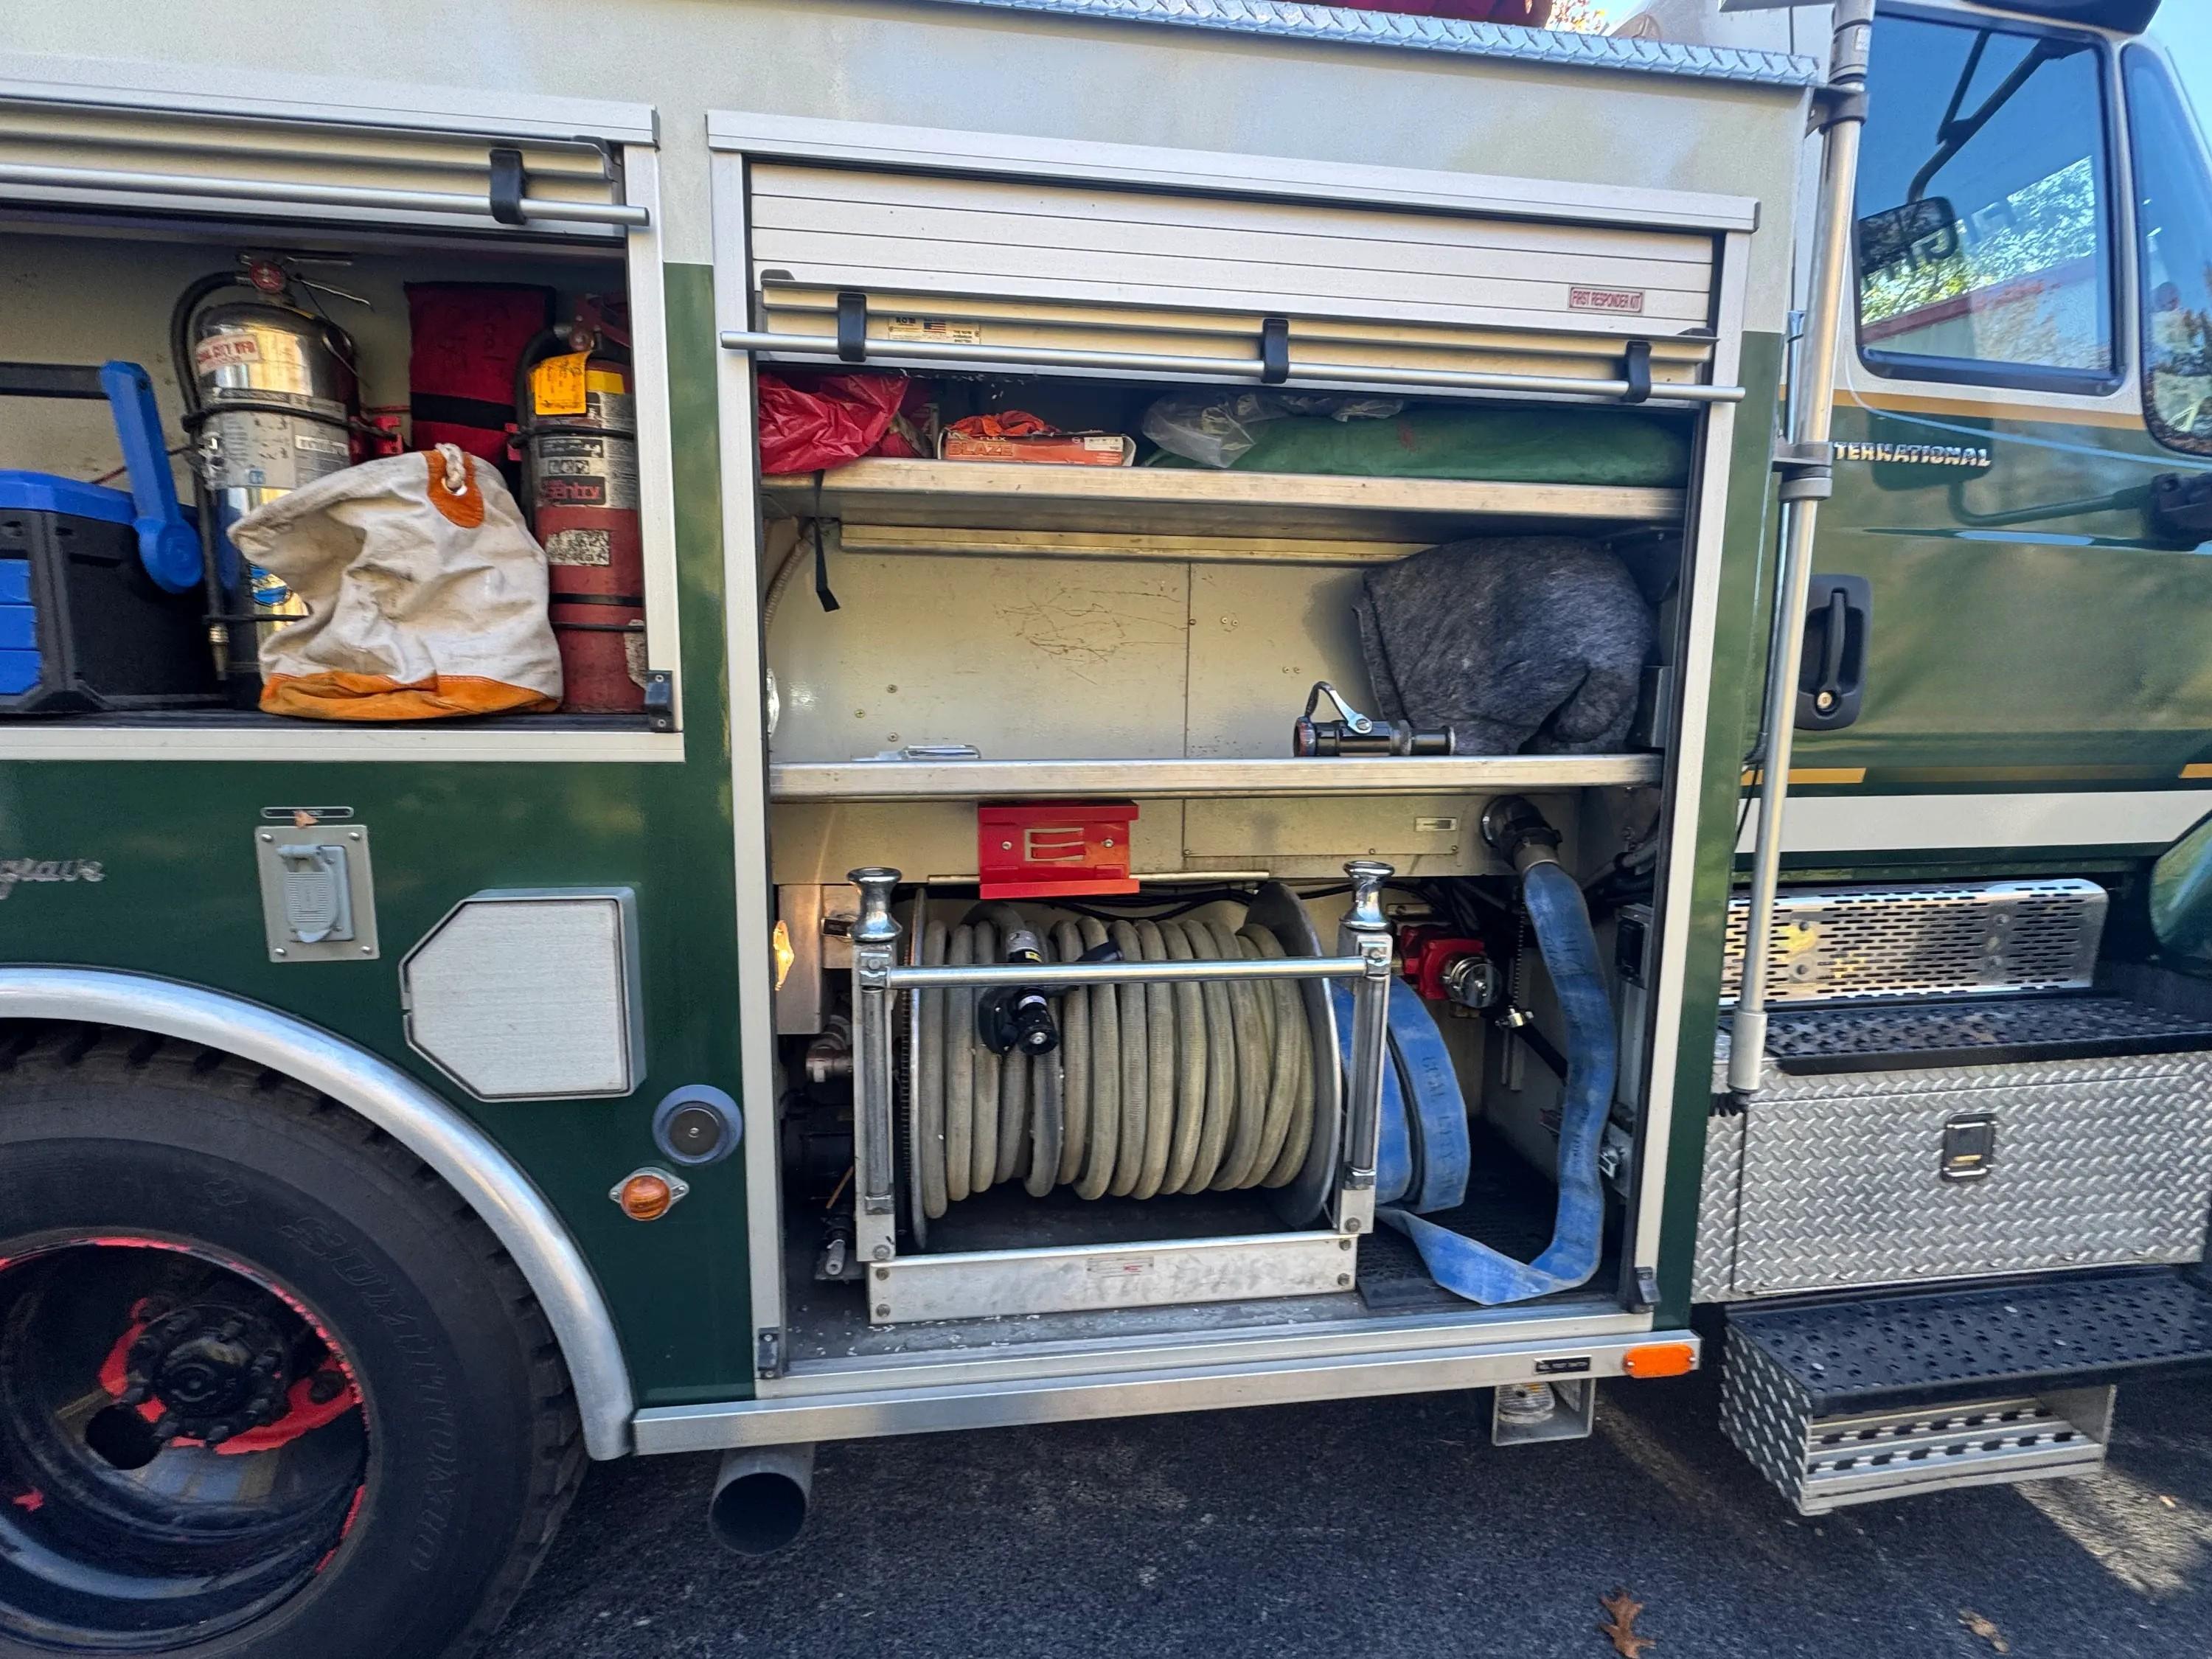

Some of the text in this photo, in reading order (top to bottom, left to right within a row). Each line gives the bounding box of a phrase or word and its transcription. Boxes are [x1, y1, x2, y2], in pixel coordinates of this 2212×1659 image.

[1573, 290, 1641, 309] FIRST RESPONDER KIT
[948, 442, 1014, 456] BLAZE
[1834, 442, 1992, 467] TERNATIONAL
